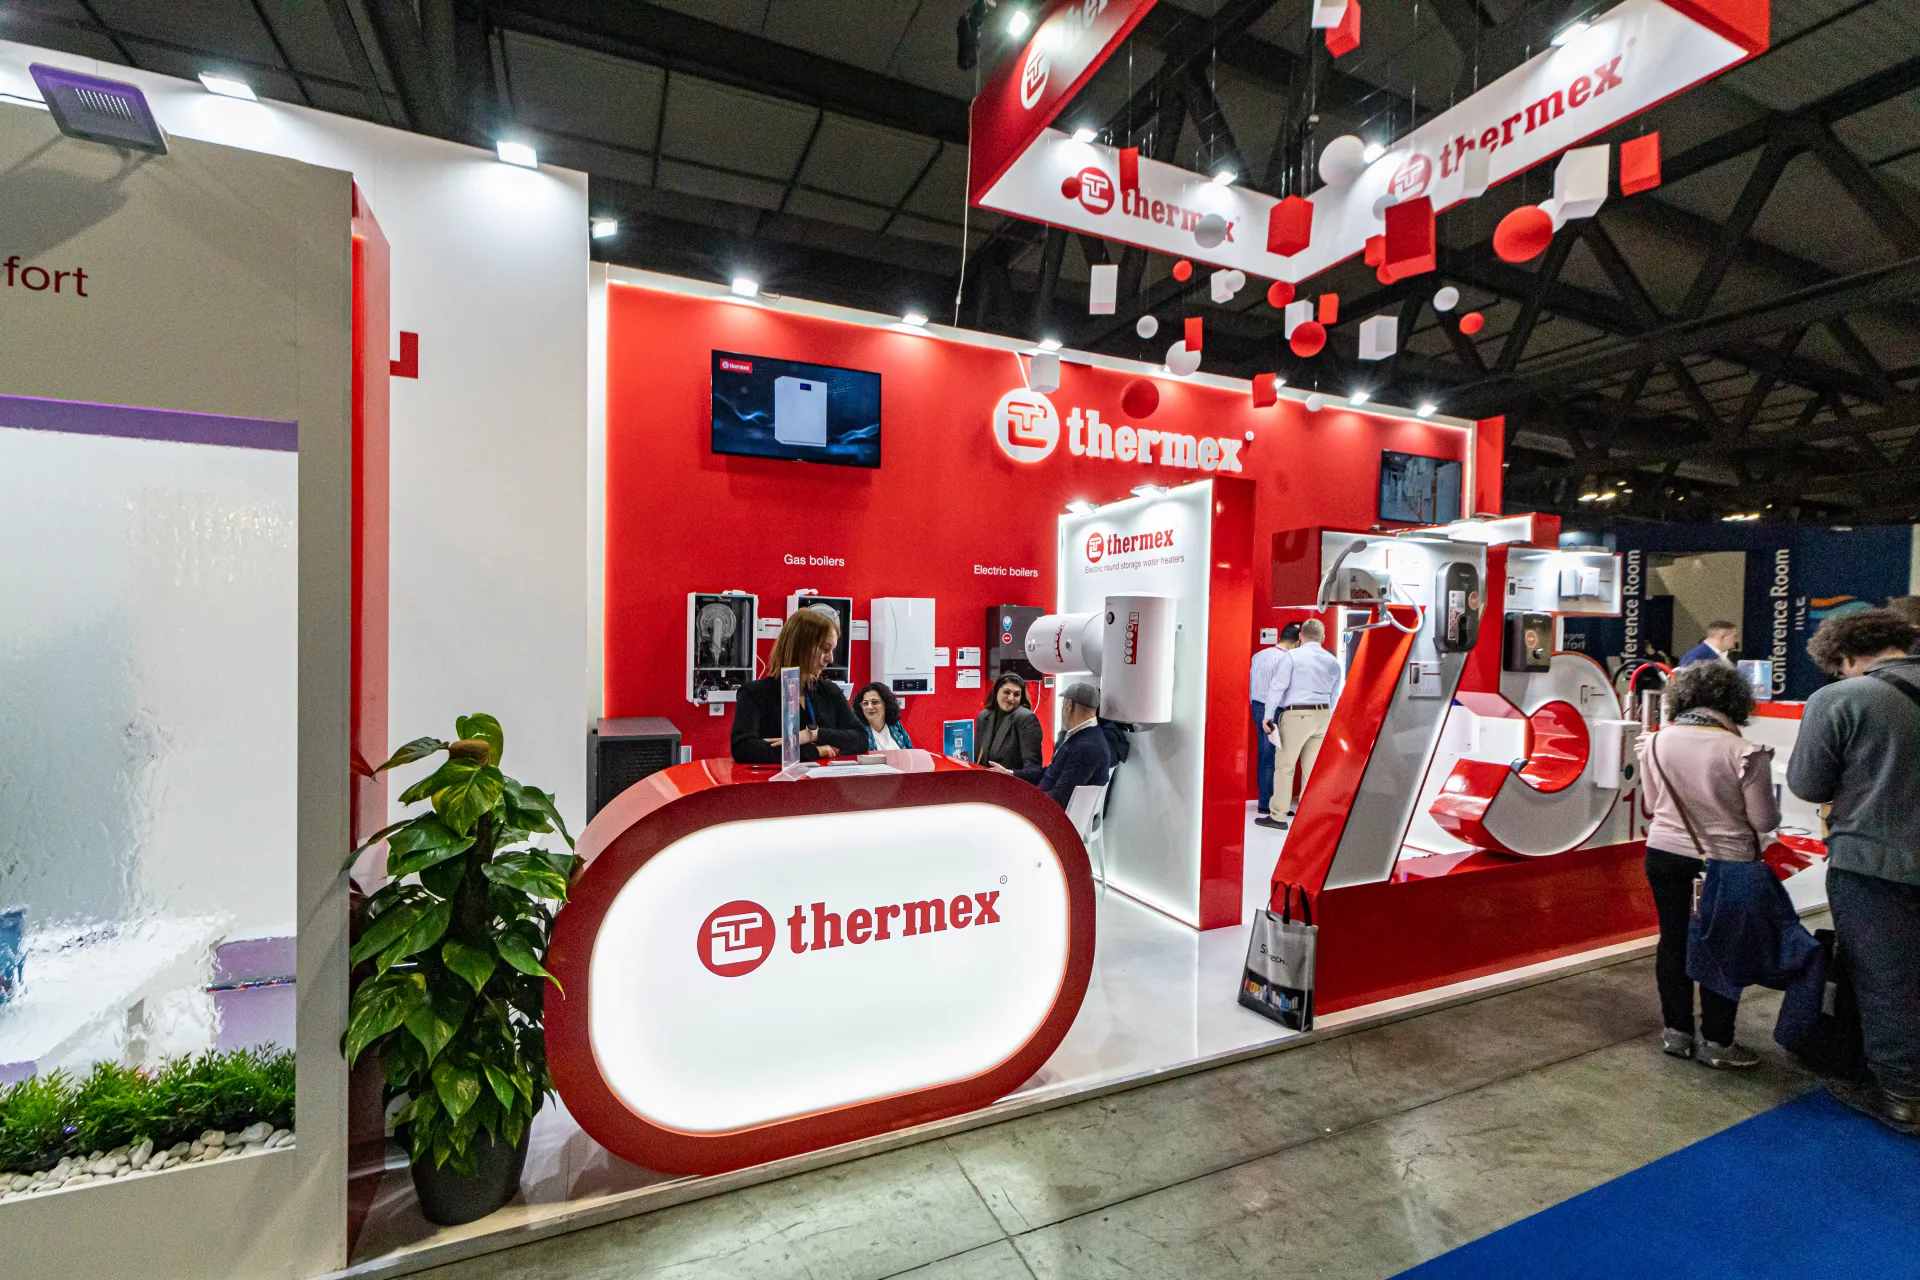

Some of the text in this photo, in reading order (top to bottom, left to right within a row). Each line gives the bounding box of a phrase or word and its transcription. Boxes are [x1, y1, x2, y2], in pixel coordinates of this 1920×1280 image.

[1439, 54, 1623, 179] thermex
[1121, 188, 1234, 243] thermx
[3, 255, 88, 297] fort
[1066, 407, 1243, 472] thermex
[784, 554, 845, 567] Gas boilers
[1084, 555, 1185, 574] Electric round storage water heaters
[1107, 529, 1174, 556] thermex
[973, 564, 1039, 578] Electric boilers
[1621, 549, 1641, 680] onference Room
[1768, 548, 1790, 695] Conference Room
[787, 890, 1001, 954] thermex
